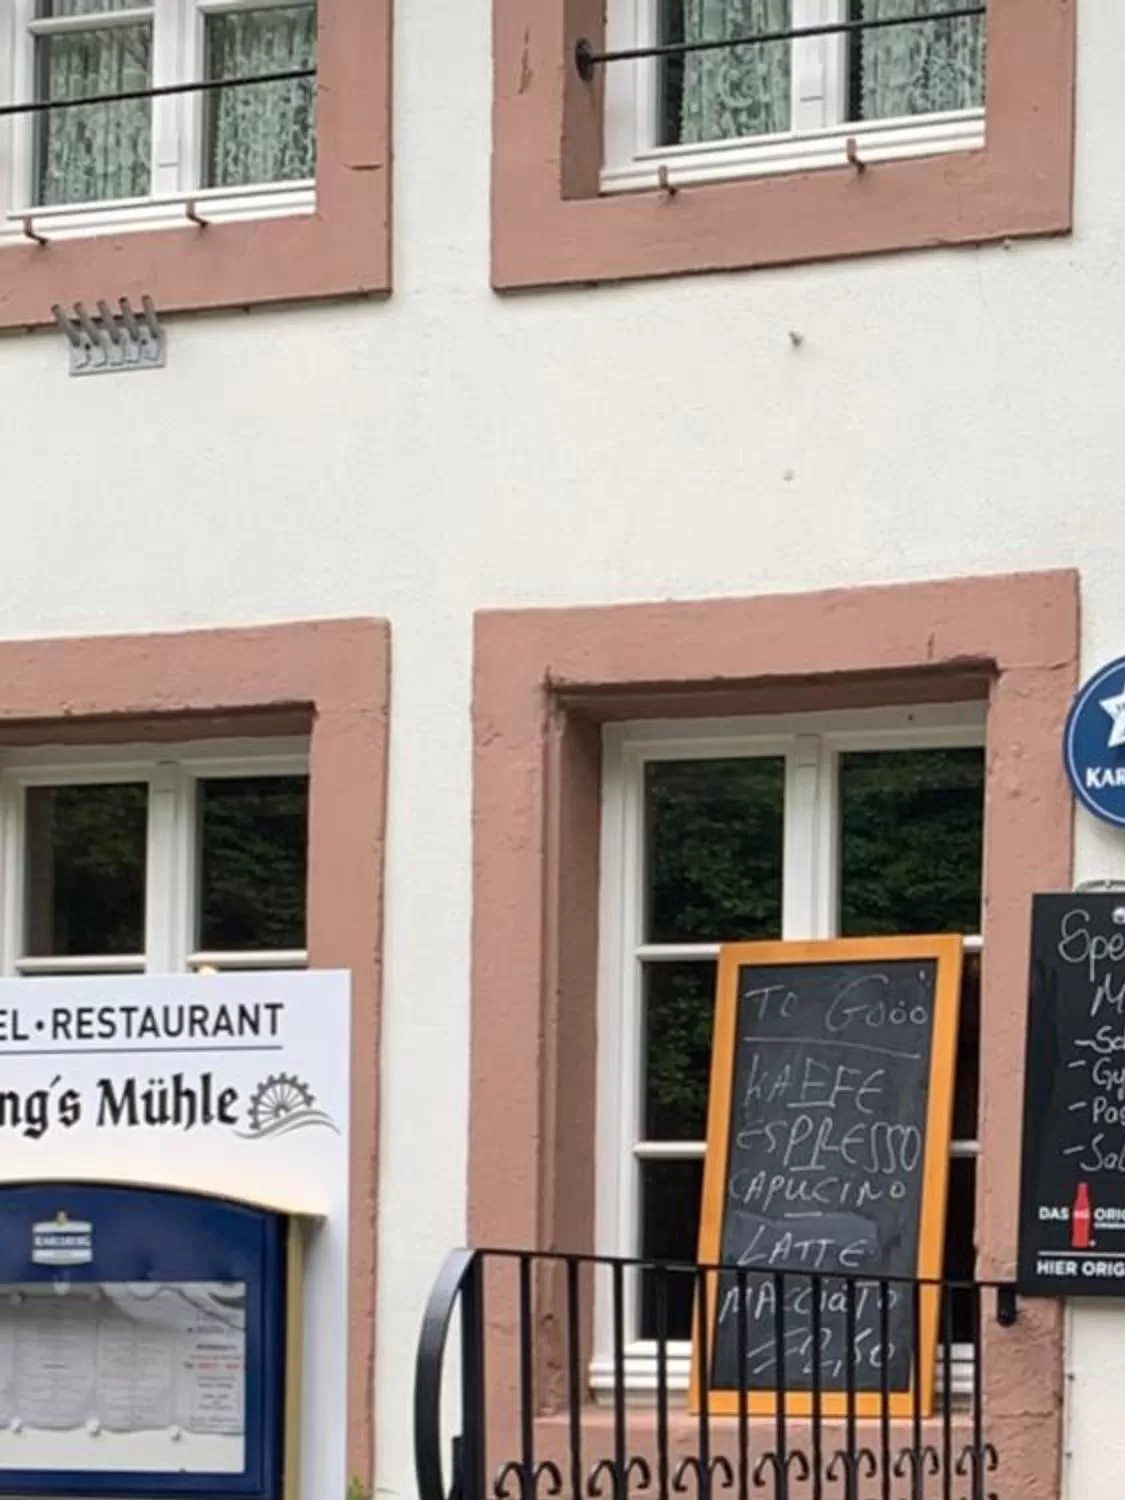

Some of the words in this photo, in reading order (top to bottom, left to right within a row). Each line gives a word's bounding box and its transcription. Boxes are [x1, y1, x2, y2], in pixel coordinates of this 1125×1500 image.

[96, 1072, 239, 1132] Mühle
[736, 1115, 921, 1174] ESPRESSO
[1038, 1206, 1069, 1221] DAS
[737, 1225, 869, 1268] LATTE
[1036, 1260, 1076, 1276] HIER
